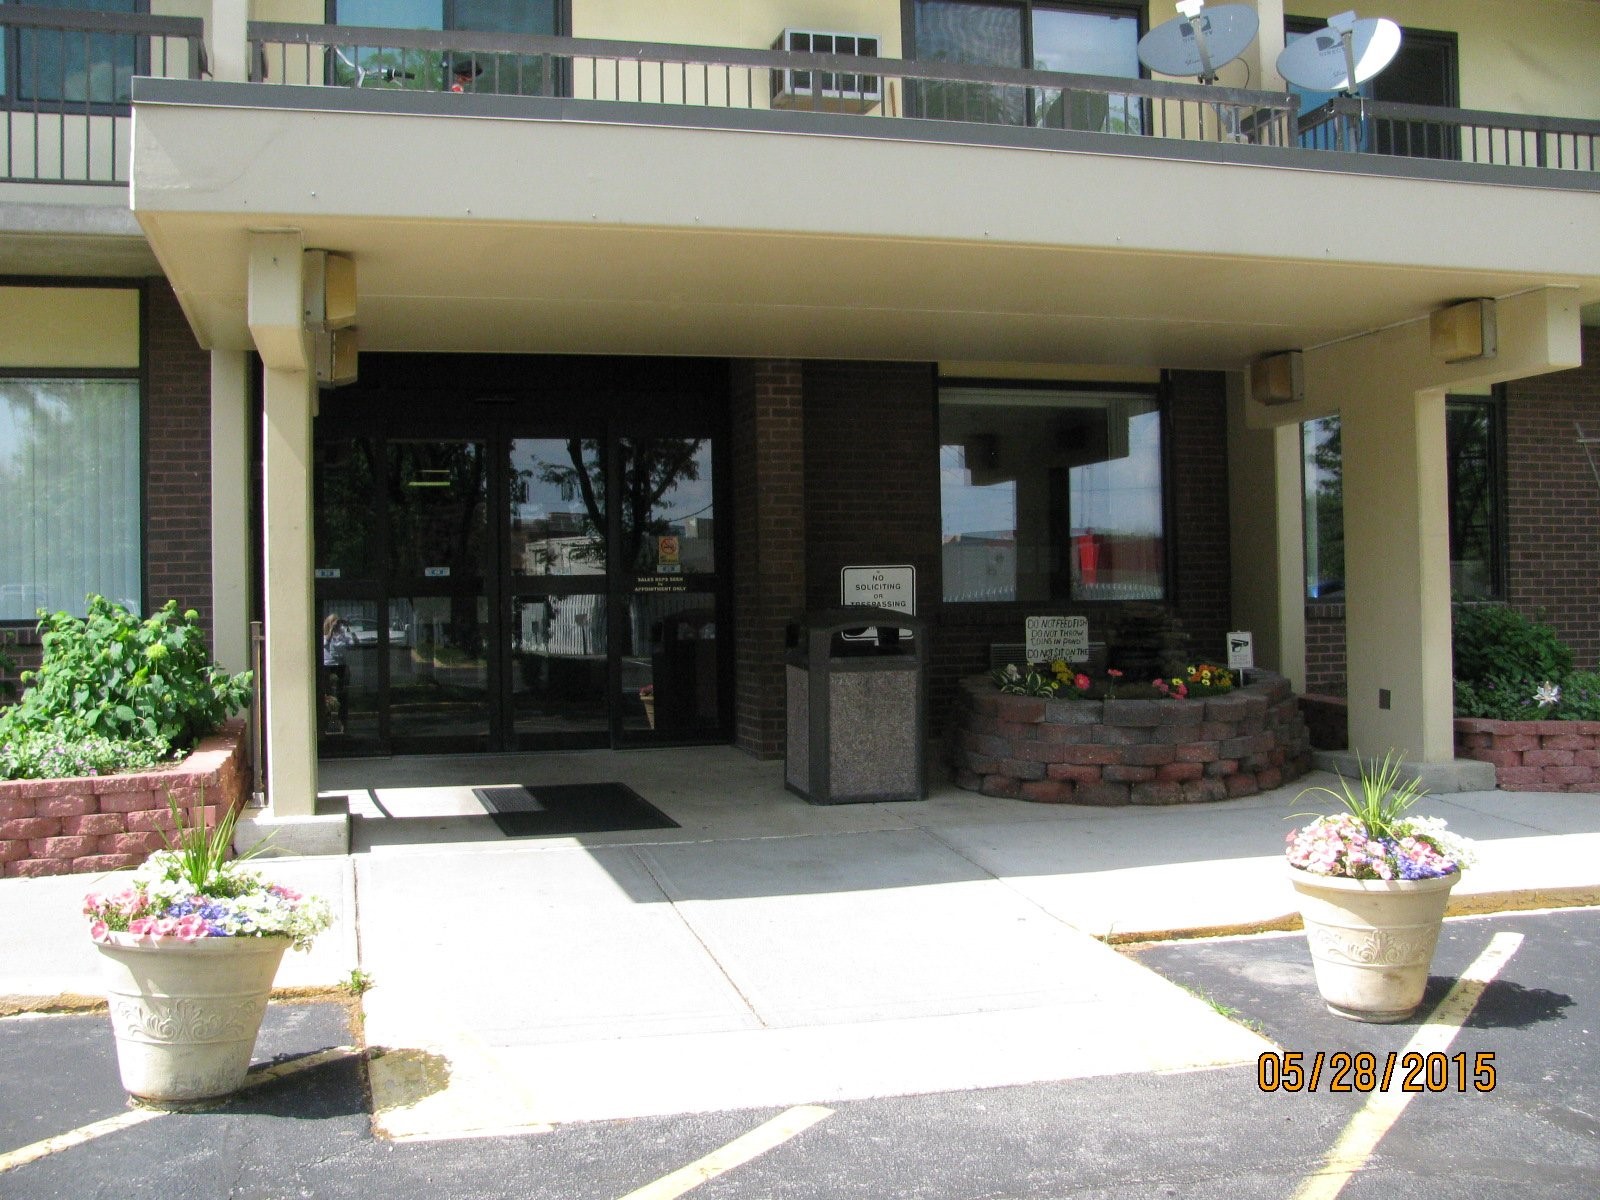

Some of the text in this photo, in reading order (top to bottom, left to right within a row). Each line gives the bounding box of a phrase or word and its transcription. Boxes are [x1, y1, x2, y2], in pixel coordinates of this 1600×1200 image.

[1027, 618, 1088, 629] DO NOT FEED FISH
[1027, 648, 1089, 658] DO NOT SIT ON THE
